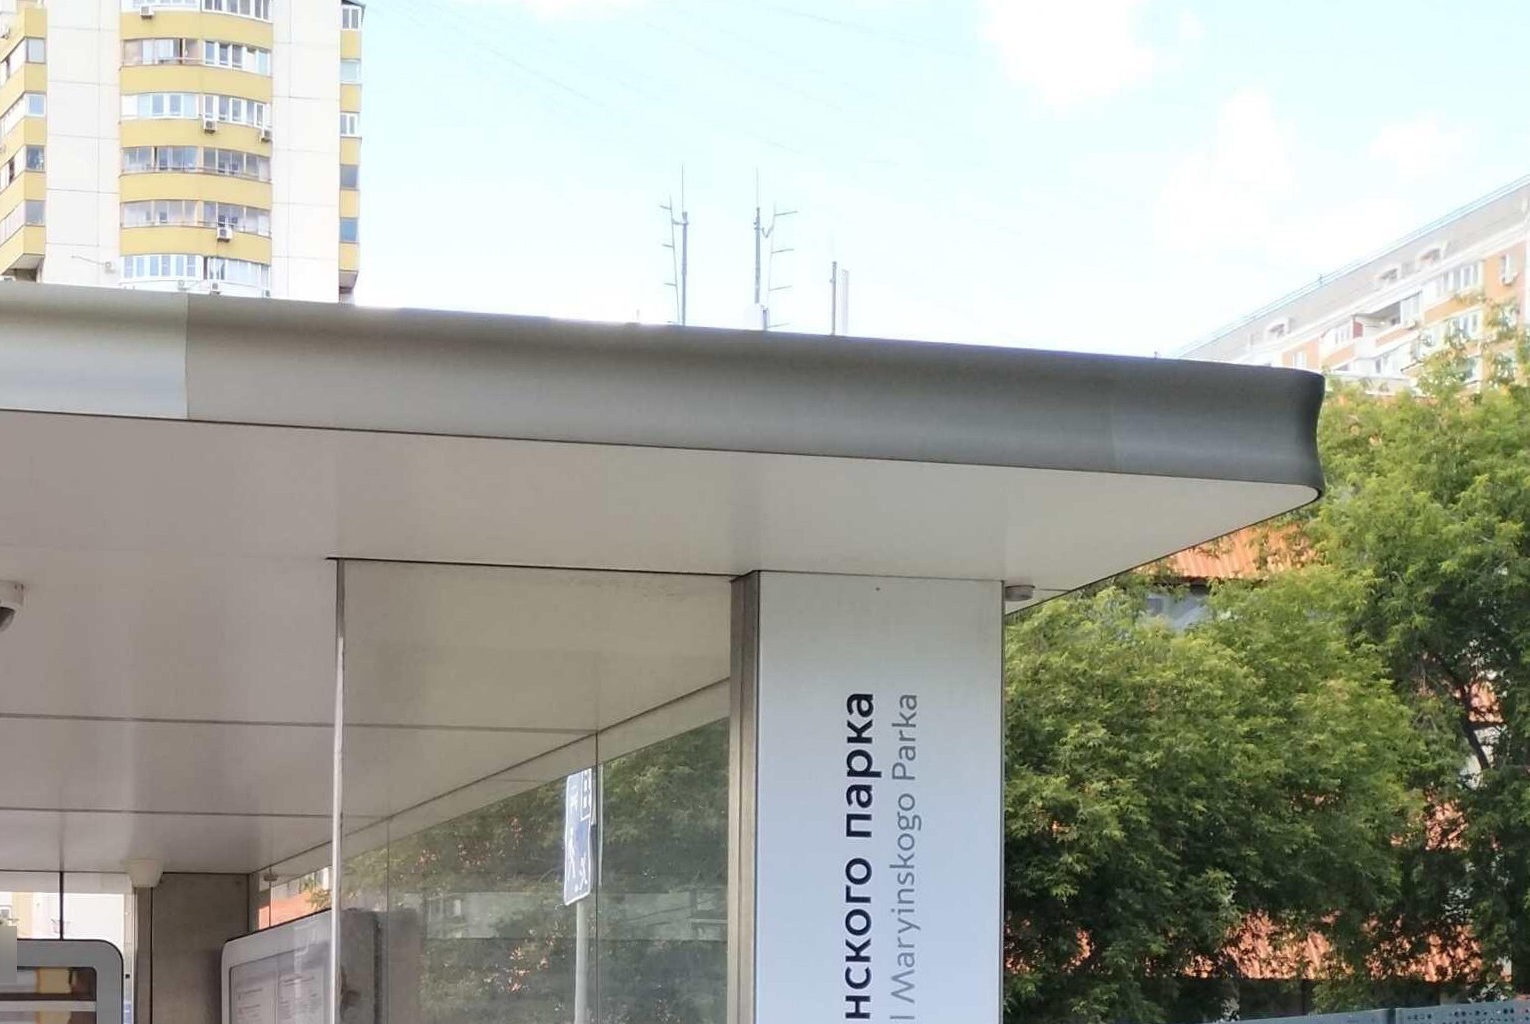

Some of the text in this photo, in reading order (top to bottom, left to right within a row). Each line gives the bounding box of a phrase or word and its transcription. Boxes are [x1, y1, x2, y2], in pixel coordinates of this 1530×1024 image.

[845, 692, 882, 837] парка
[891, 693, 918, 781] Parka
[889, 792, 922, 1003] Maryinskogo
